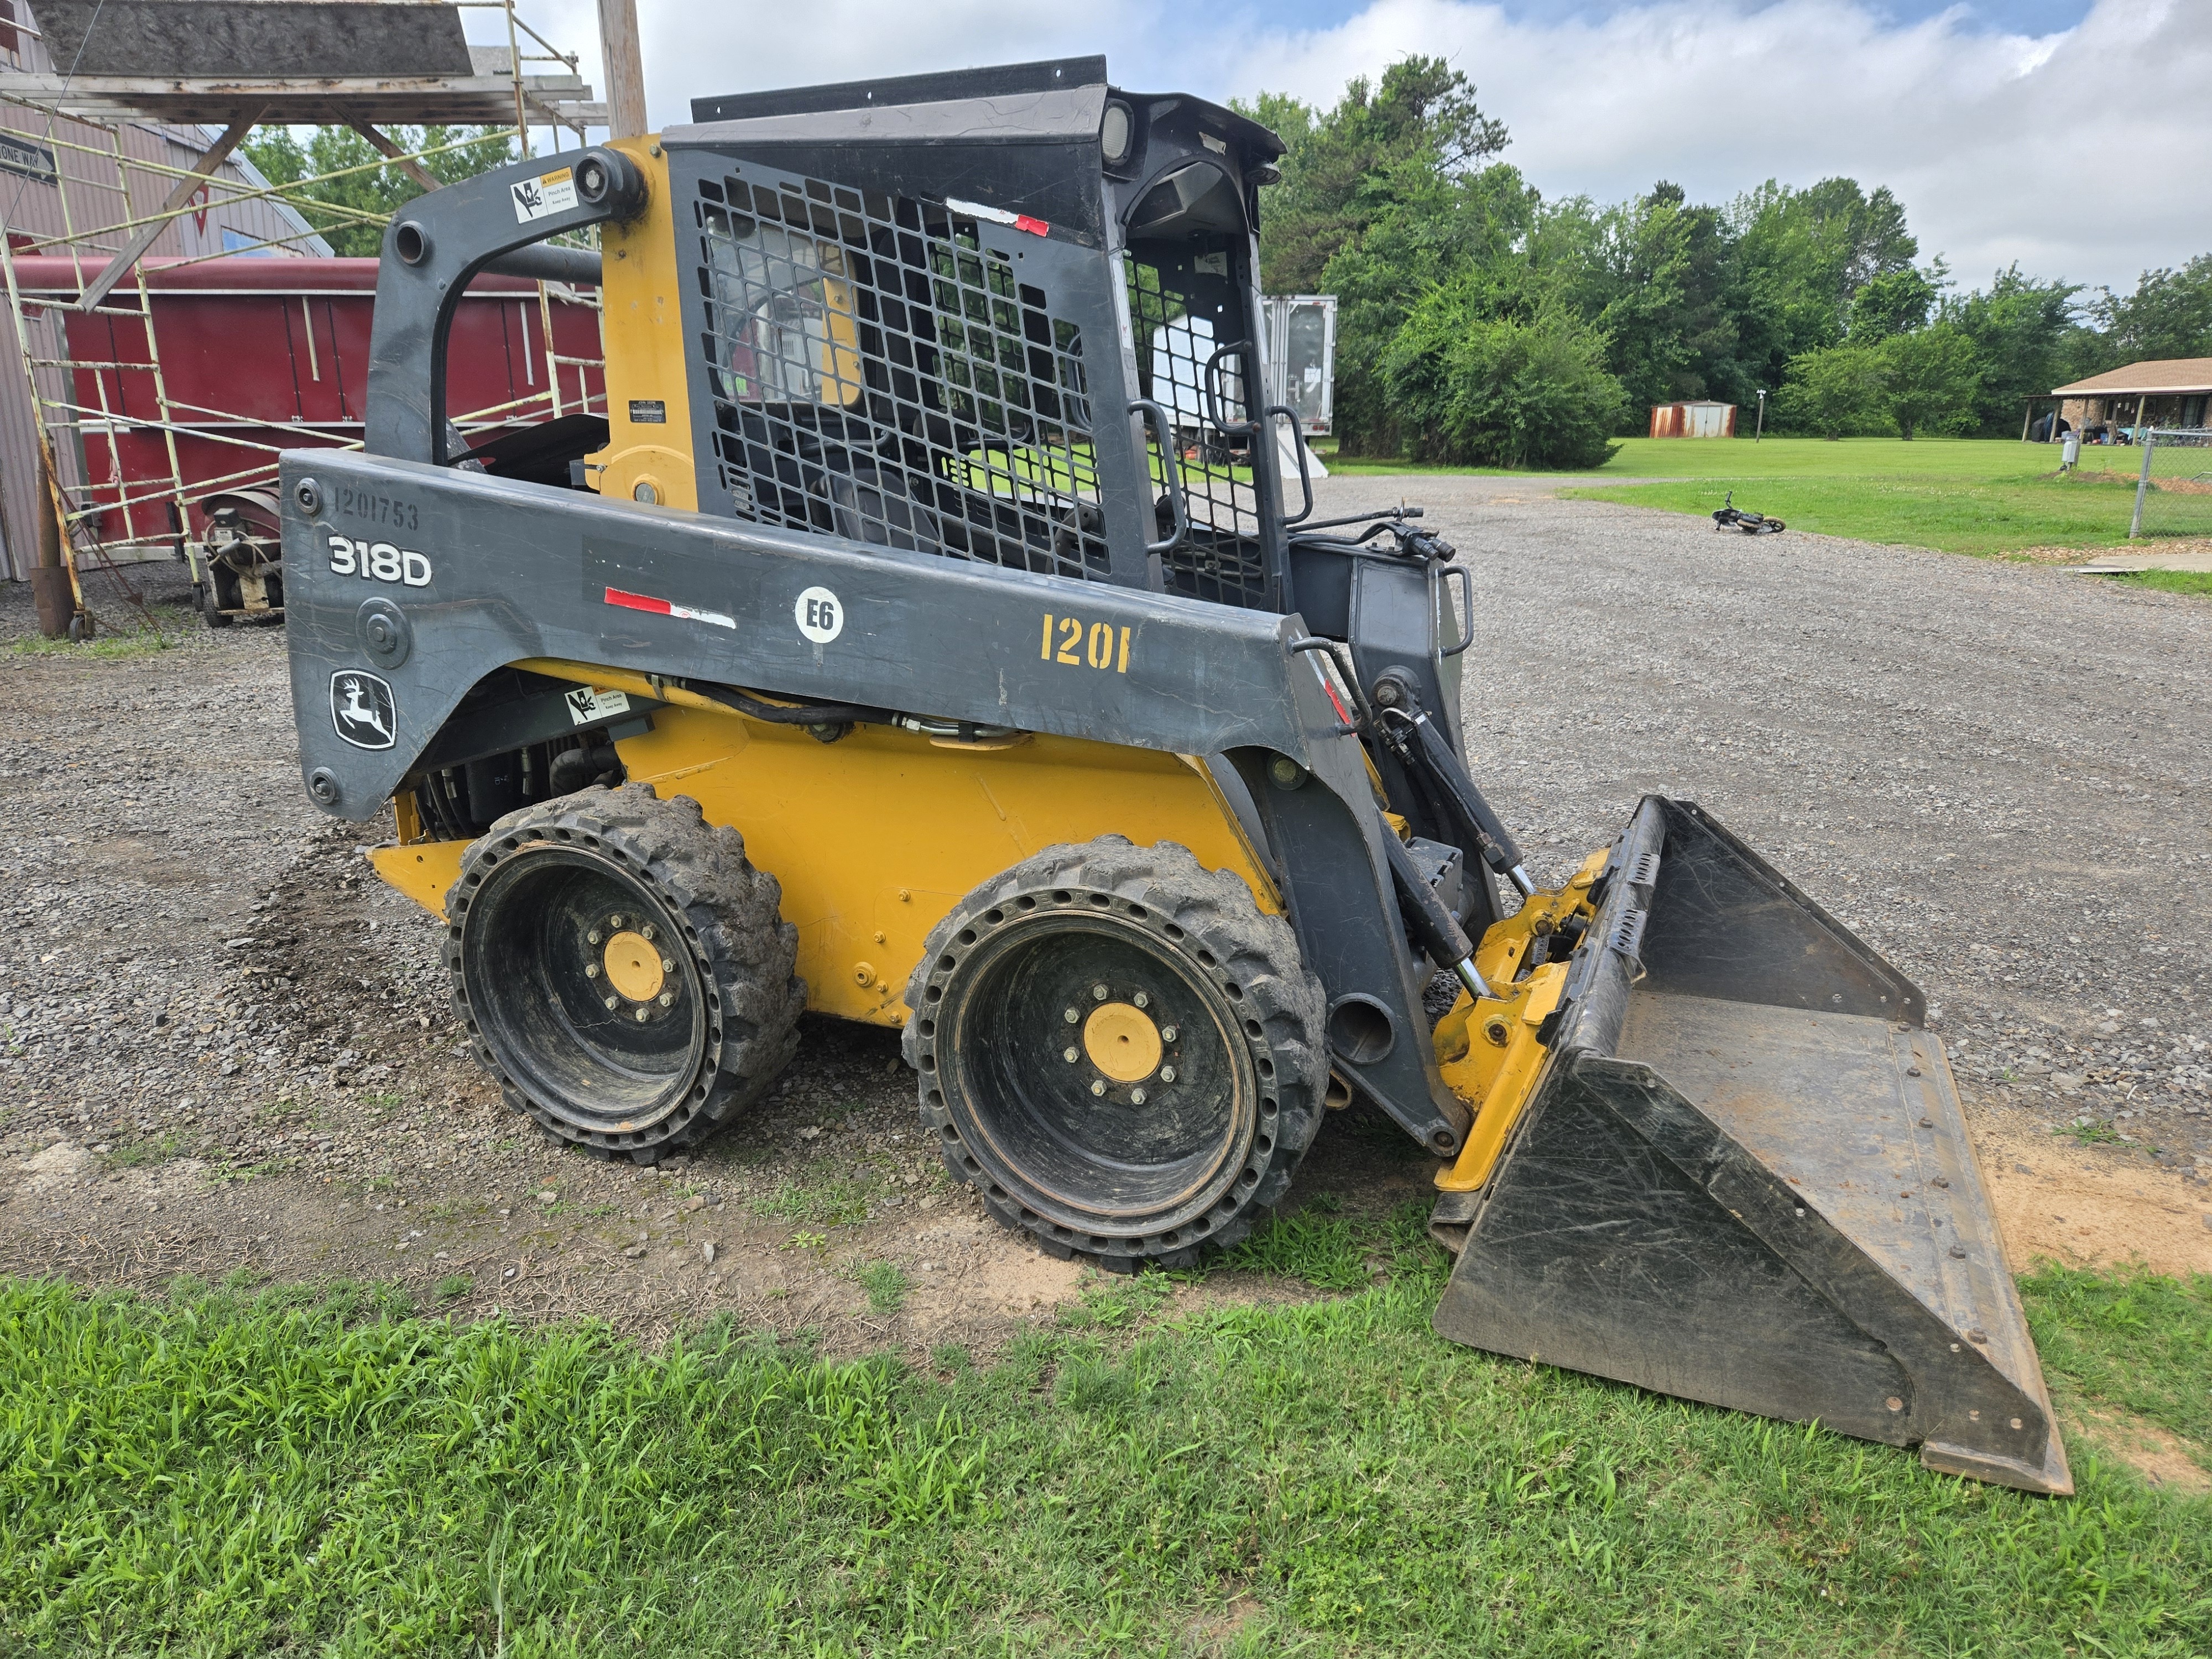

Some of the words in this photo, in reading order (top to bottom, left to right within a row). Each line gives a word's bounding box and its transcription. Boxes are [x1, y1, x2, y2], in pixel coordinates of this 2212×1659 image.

[2, 145, 20, 163] ONE
[22, 152, 39, 168] WAY
[547, 172, 569, 182] WARNING
[335, 487, 419, 531] 1201753
[327, 535, 433, 587] 318D
[806, 598, 834, 630] E6
[1041, 614, 1131, 674] 1201
[922, 892, 1126, 1019] SOLIDEAL
